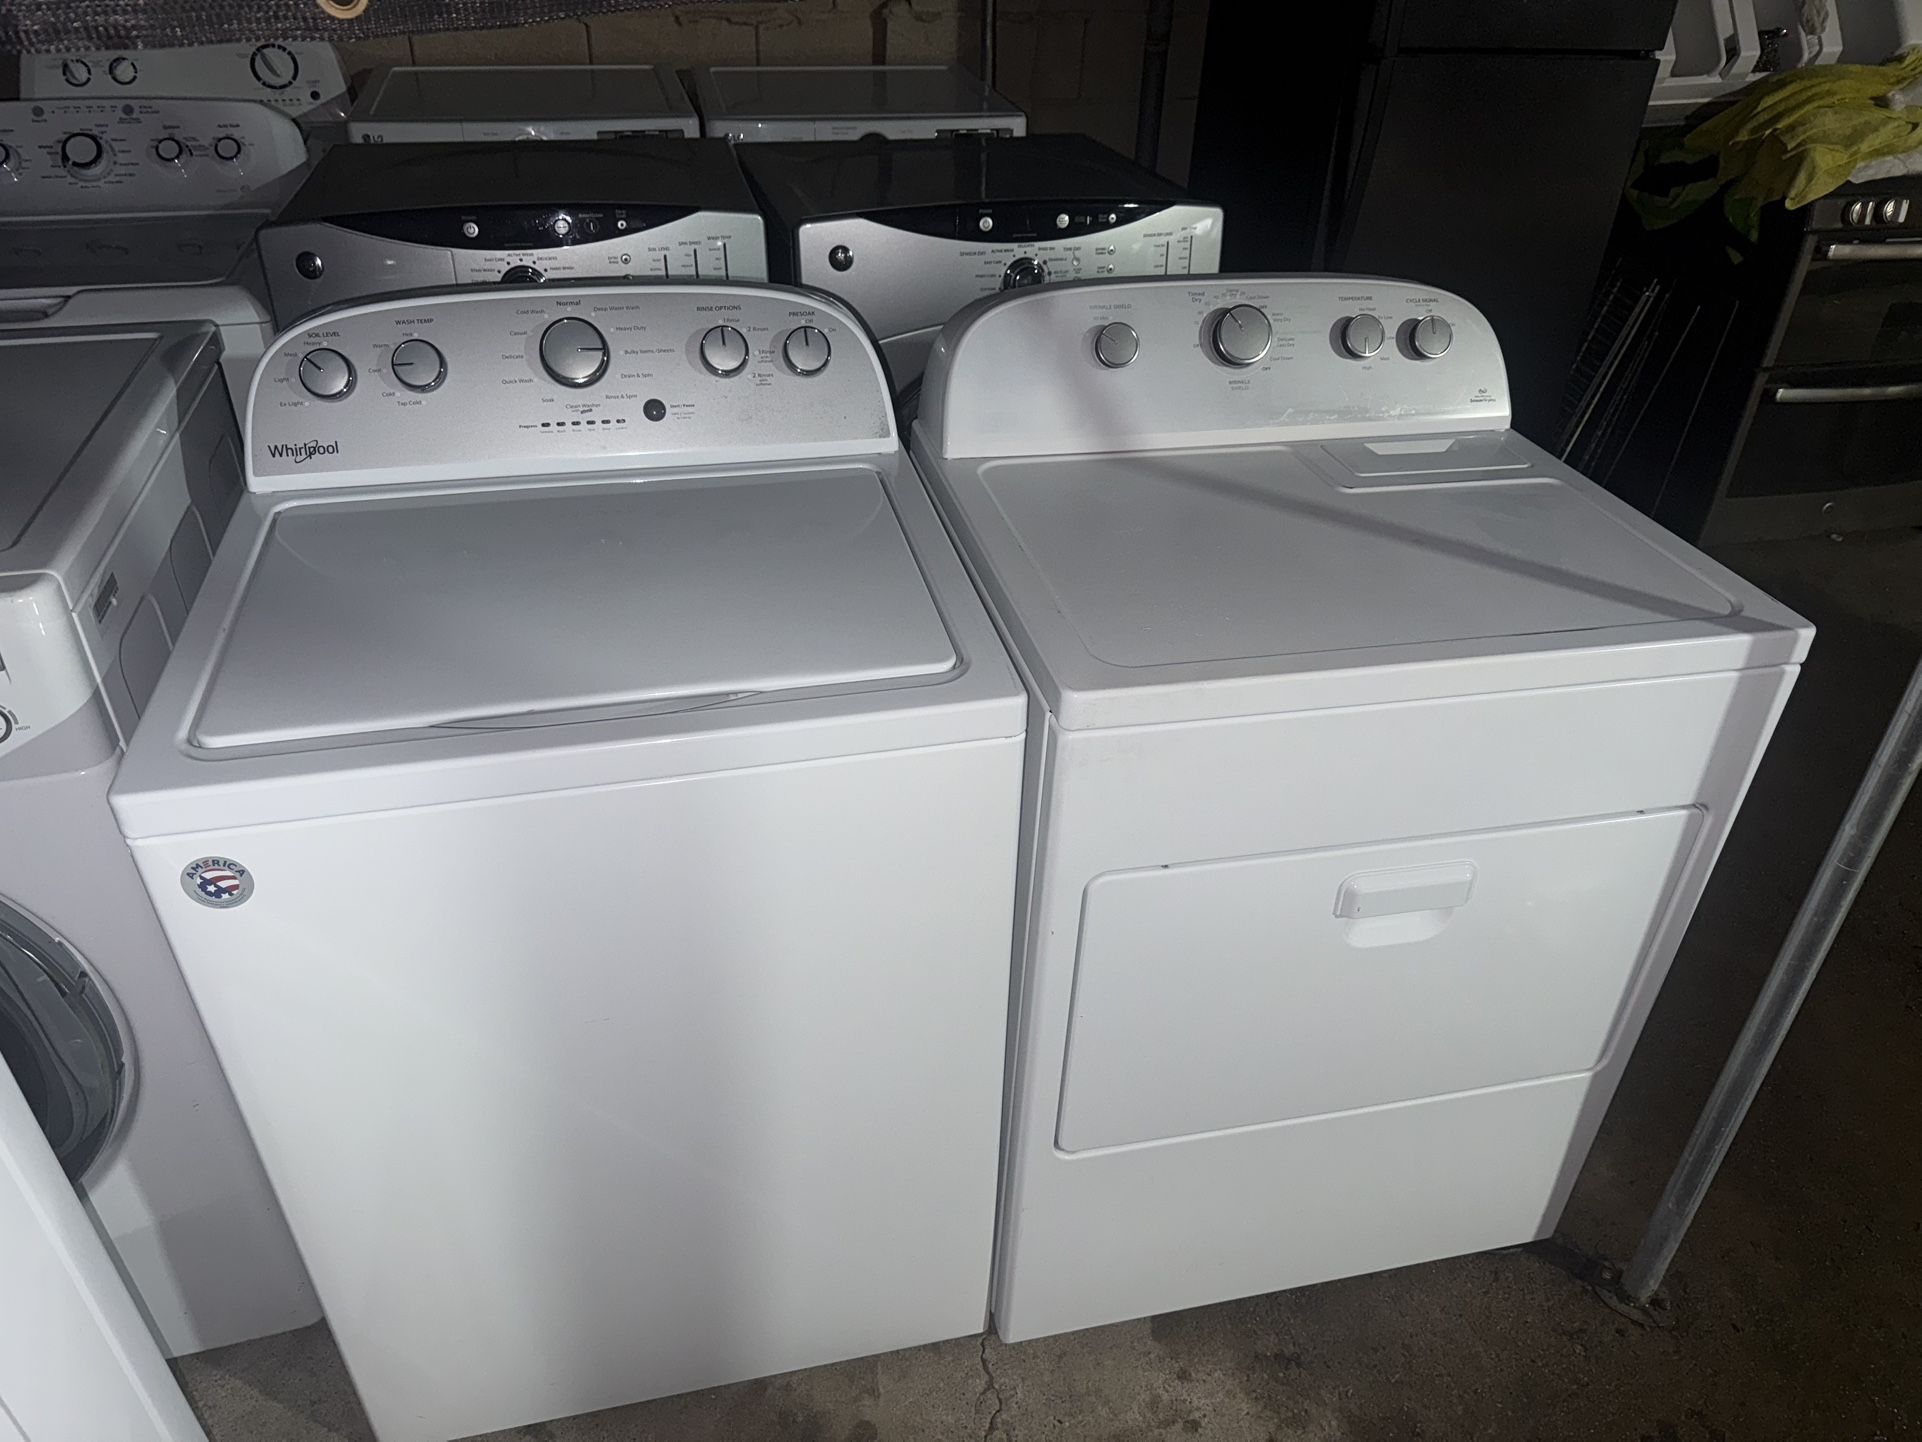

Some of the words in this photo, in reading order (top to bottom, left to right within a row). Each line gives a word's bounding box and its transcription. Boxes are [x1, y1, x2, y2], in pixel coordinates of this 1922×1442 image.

[556, 299, 582, 307] Normal
[274, 376, 290, 384] Light
[268, 439, 339, 463] Whirlpool
[186, 859, 246, 880] AMERICA
